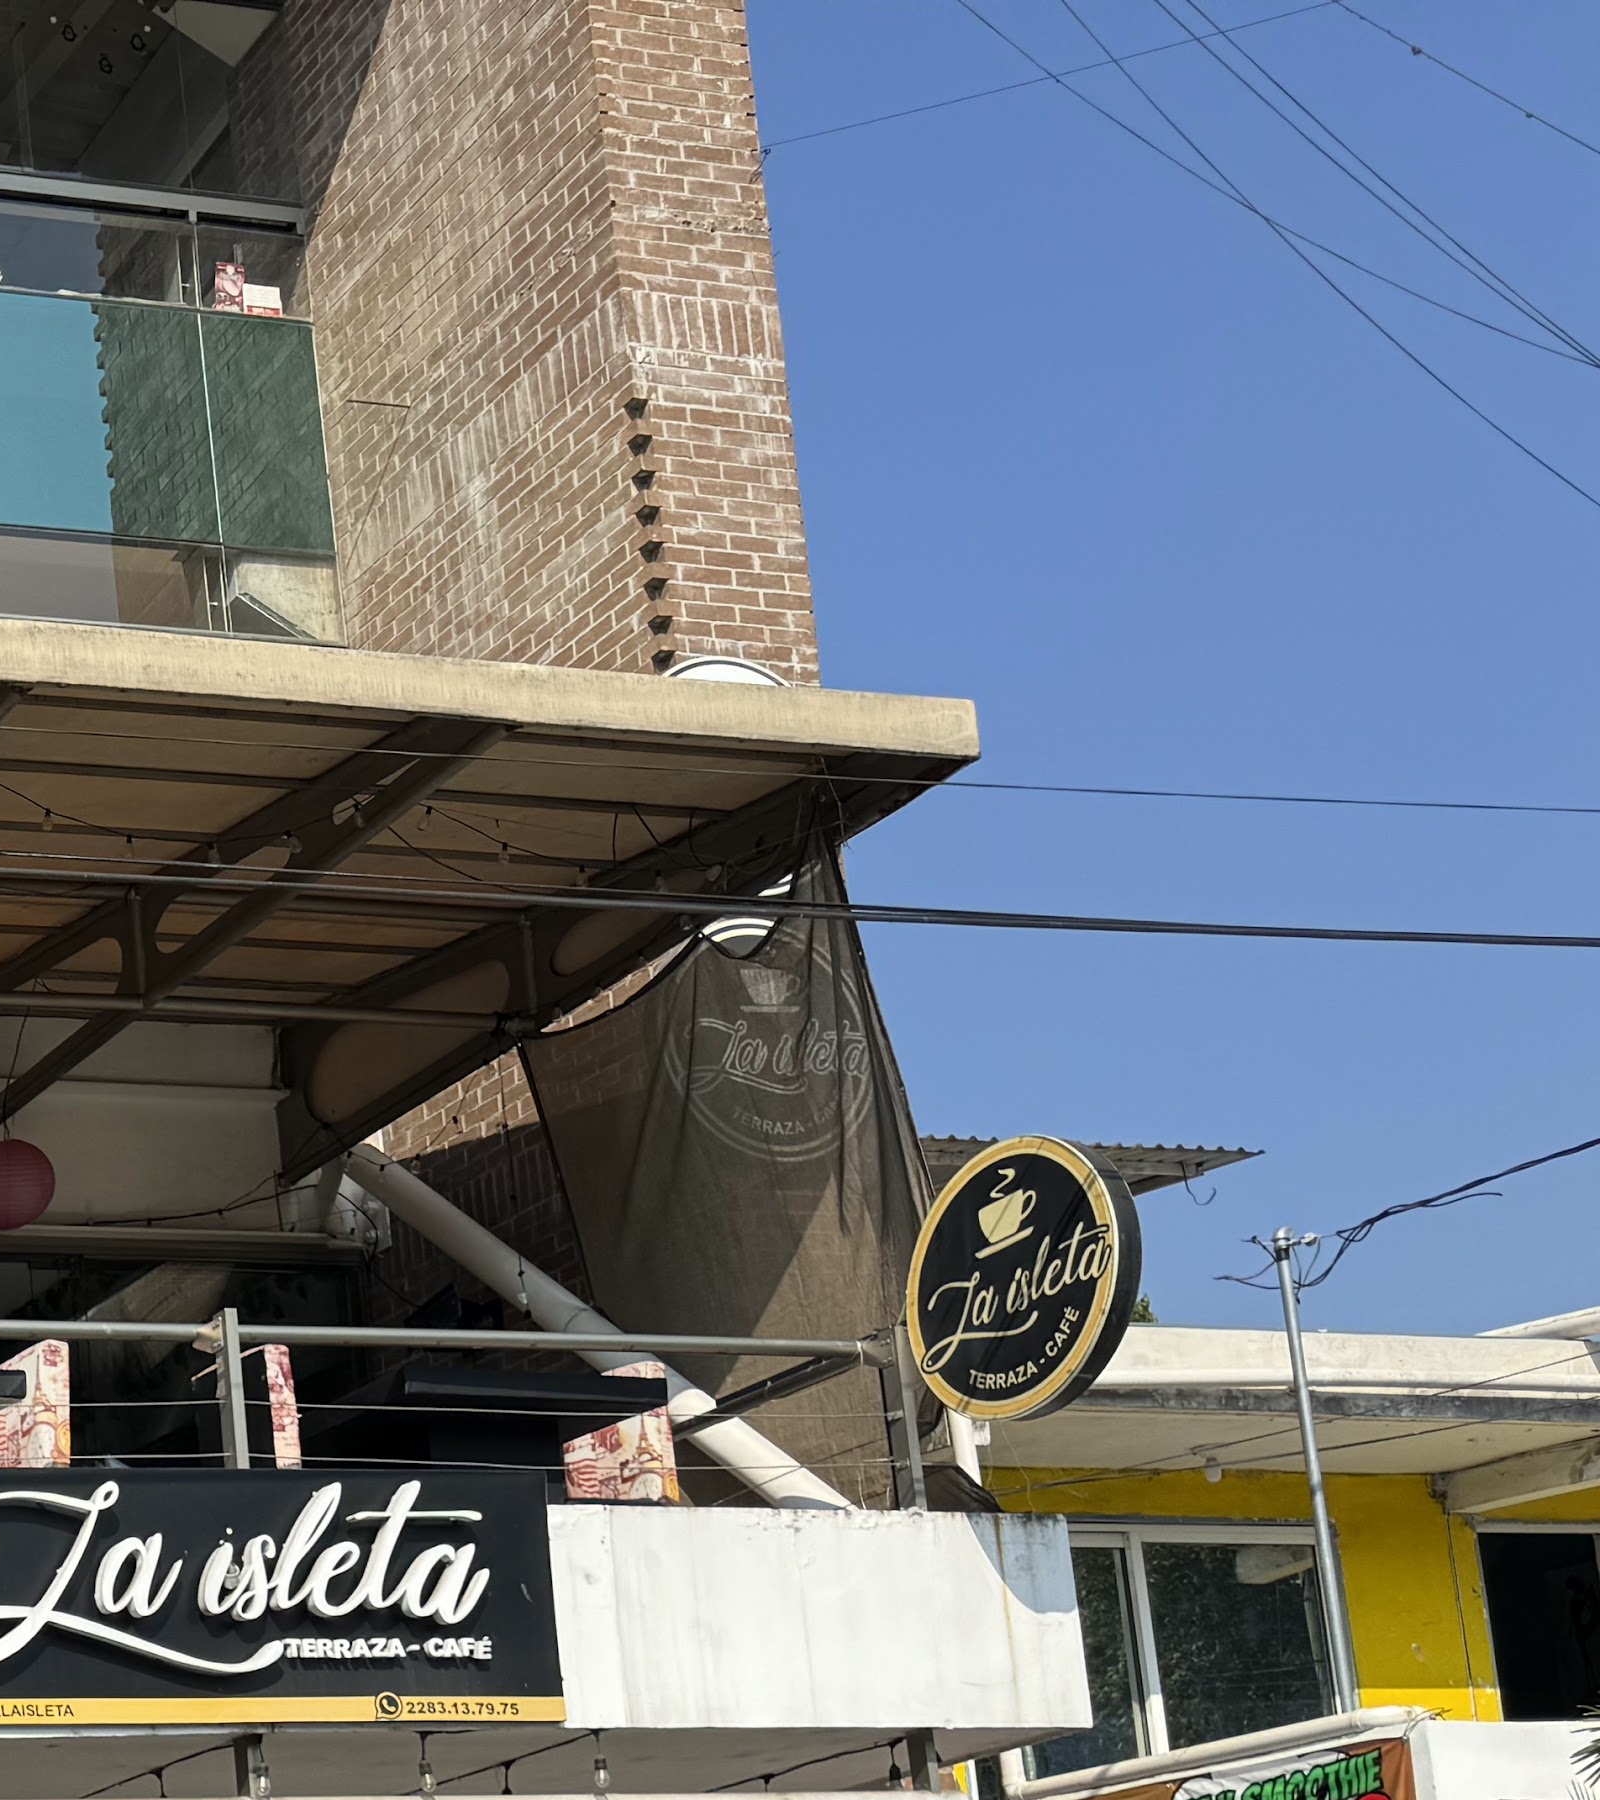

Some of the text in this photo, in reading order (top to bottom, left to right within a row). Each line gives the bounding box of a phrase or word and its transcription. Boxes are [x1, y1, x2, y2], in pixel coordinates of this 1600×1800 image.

[732, 1106, 805, 1136] TERRAZA
[923, 1221, 1112, 1373] La isleta
[968, 1359, 1039, 1390] TERRAZA
[1044, 1305, 1080, 1357] CAFÉ
[197, 1479, 492, 1625] isleta
[423, 1635, 493, 1660] CAFÉ
[405, 1700, 520, 1716] 2283.13.79.75
